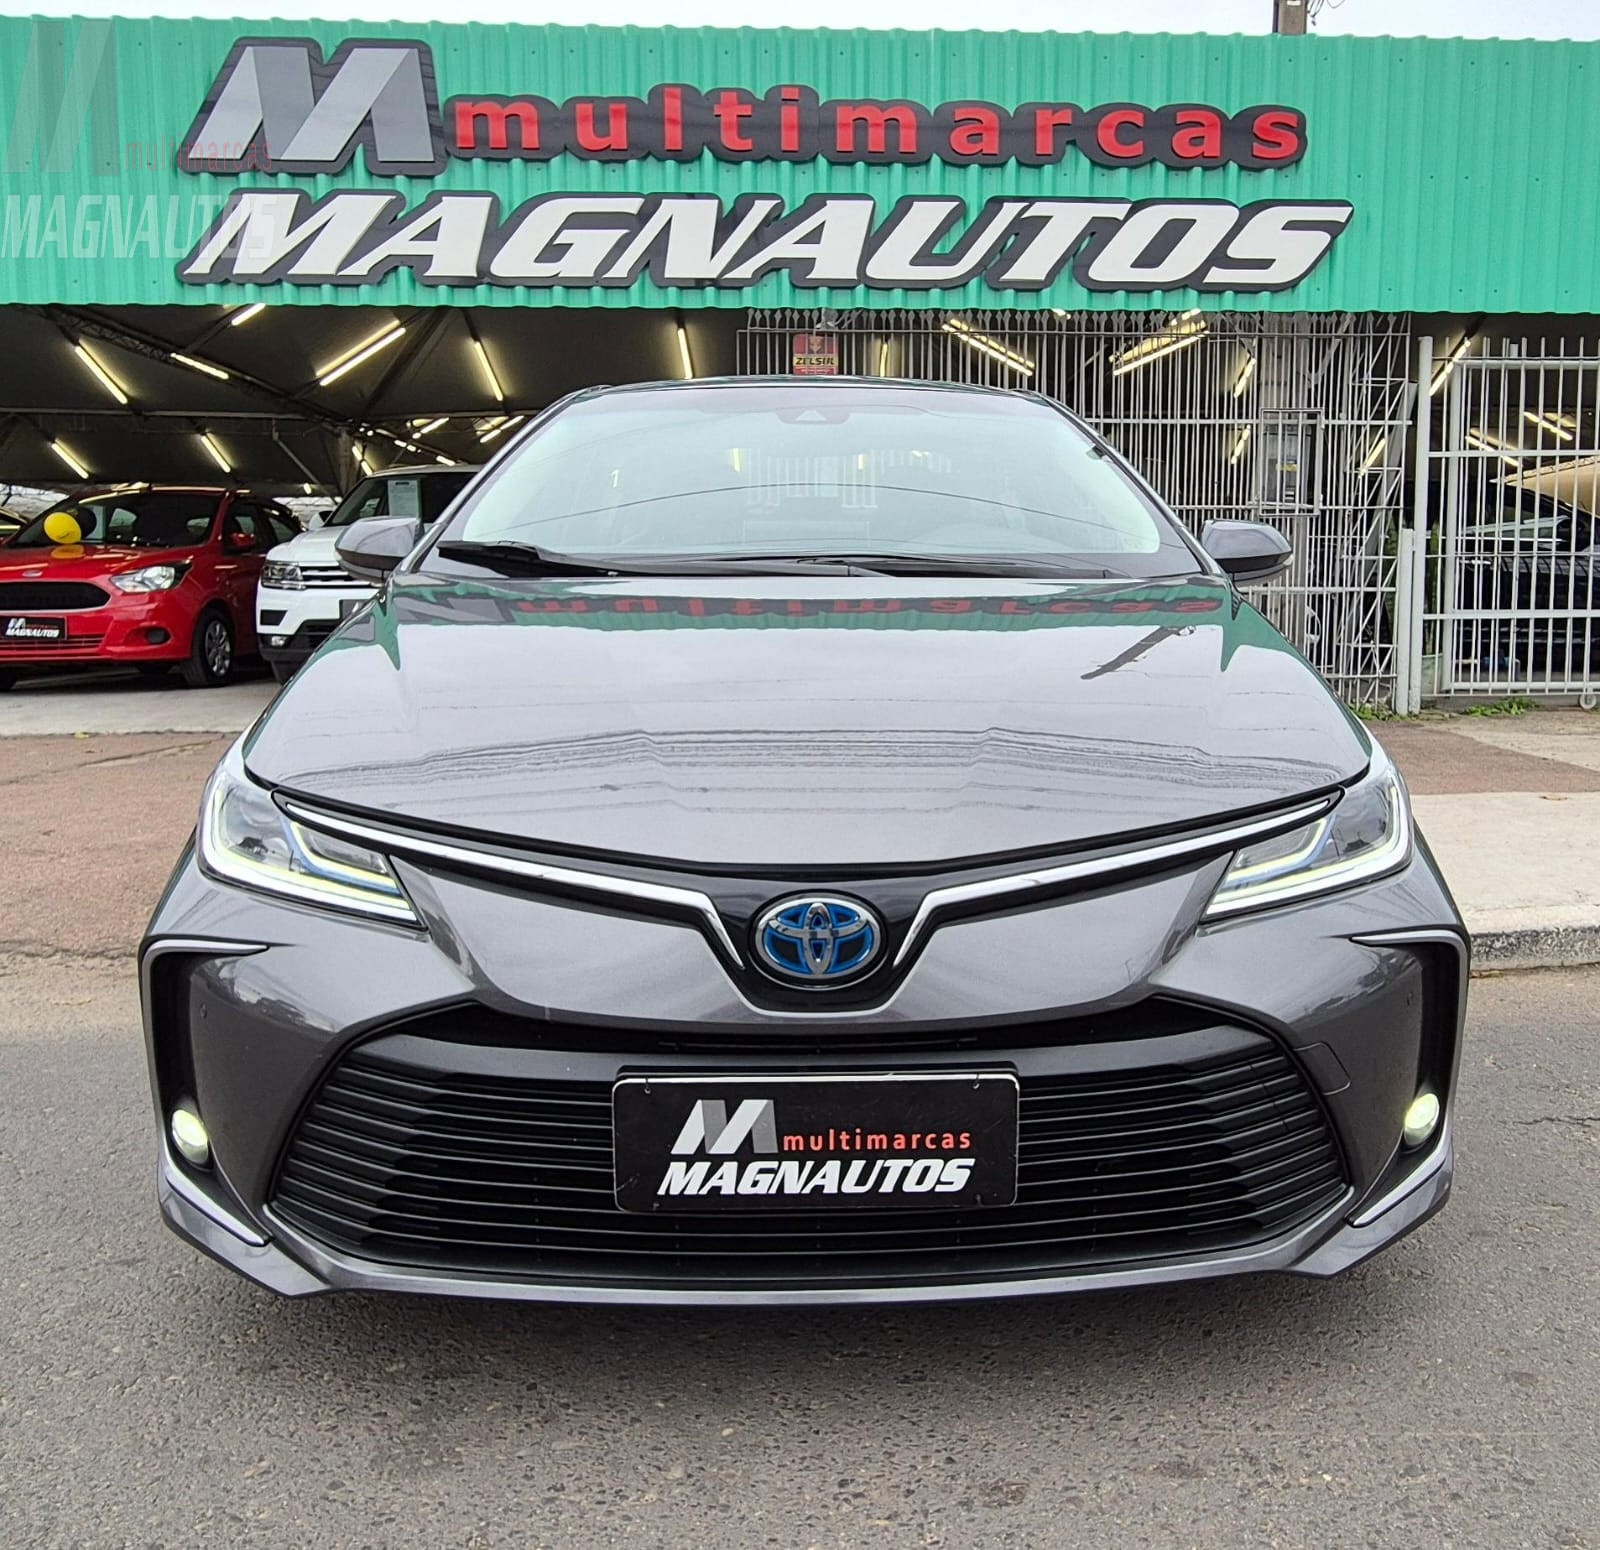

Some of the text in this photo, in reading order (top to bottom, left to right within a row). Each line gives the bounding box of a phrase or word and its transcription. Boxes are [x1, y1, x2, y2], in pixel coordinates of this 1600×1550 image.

[187, 46, 1300, 162] M multimarcas
[183, 193, 1353, 284] MAGNAUTOS
[670, 1099, 972, 1154] M multimarcas
[657, 1158, 976, 1196] MAGNAUTOS
